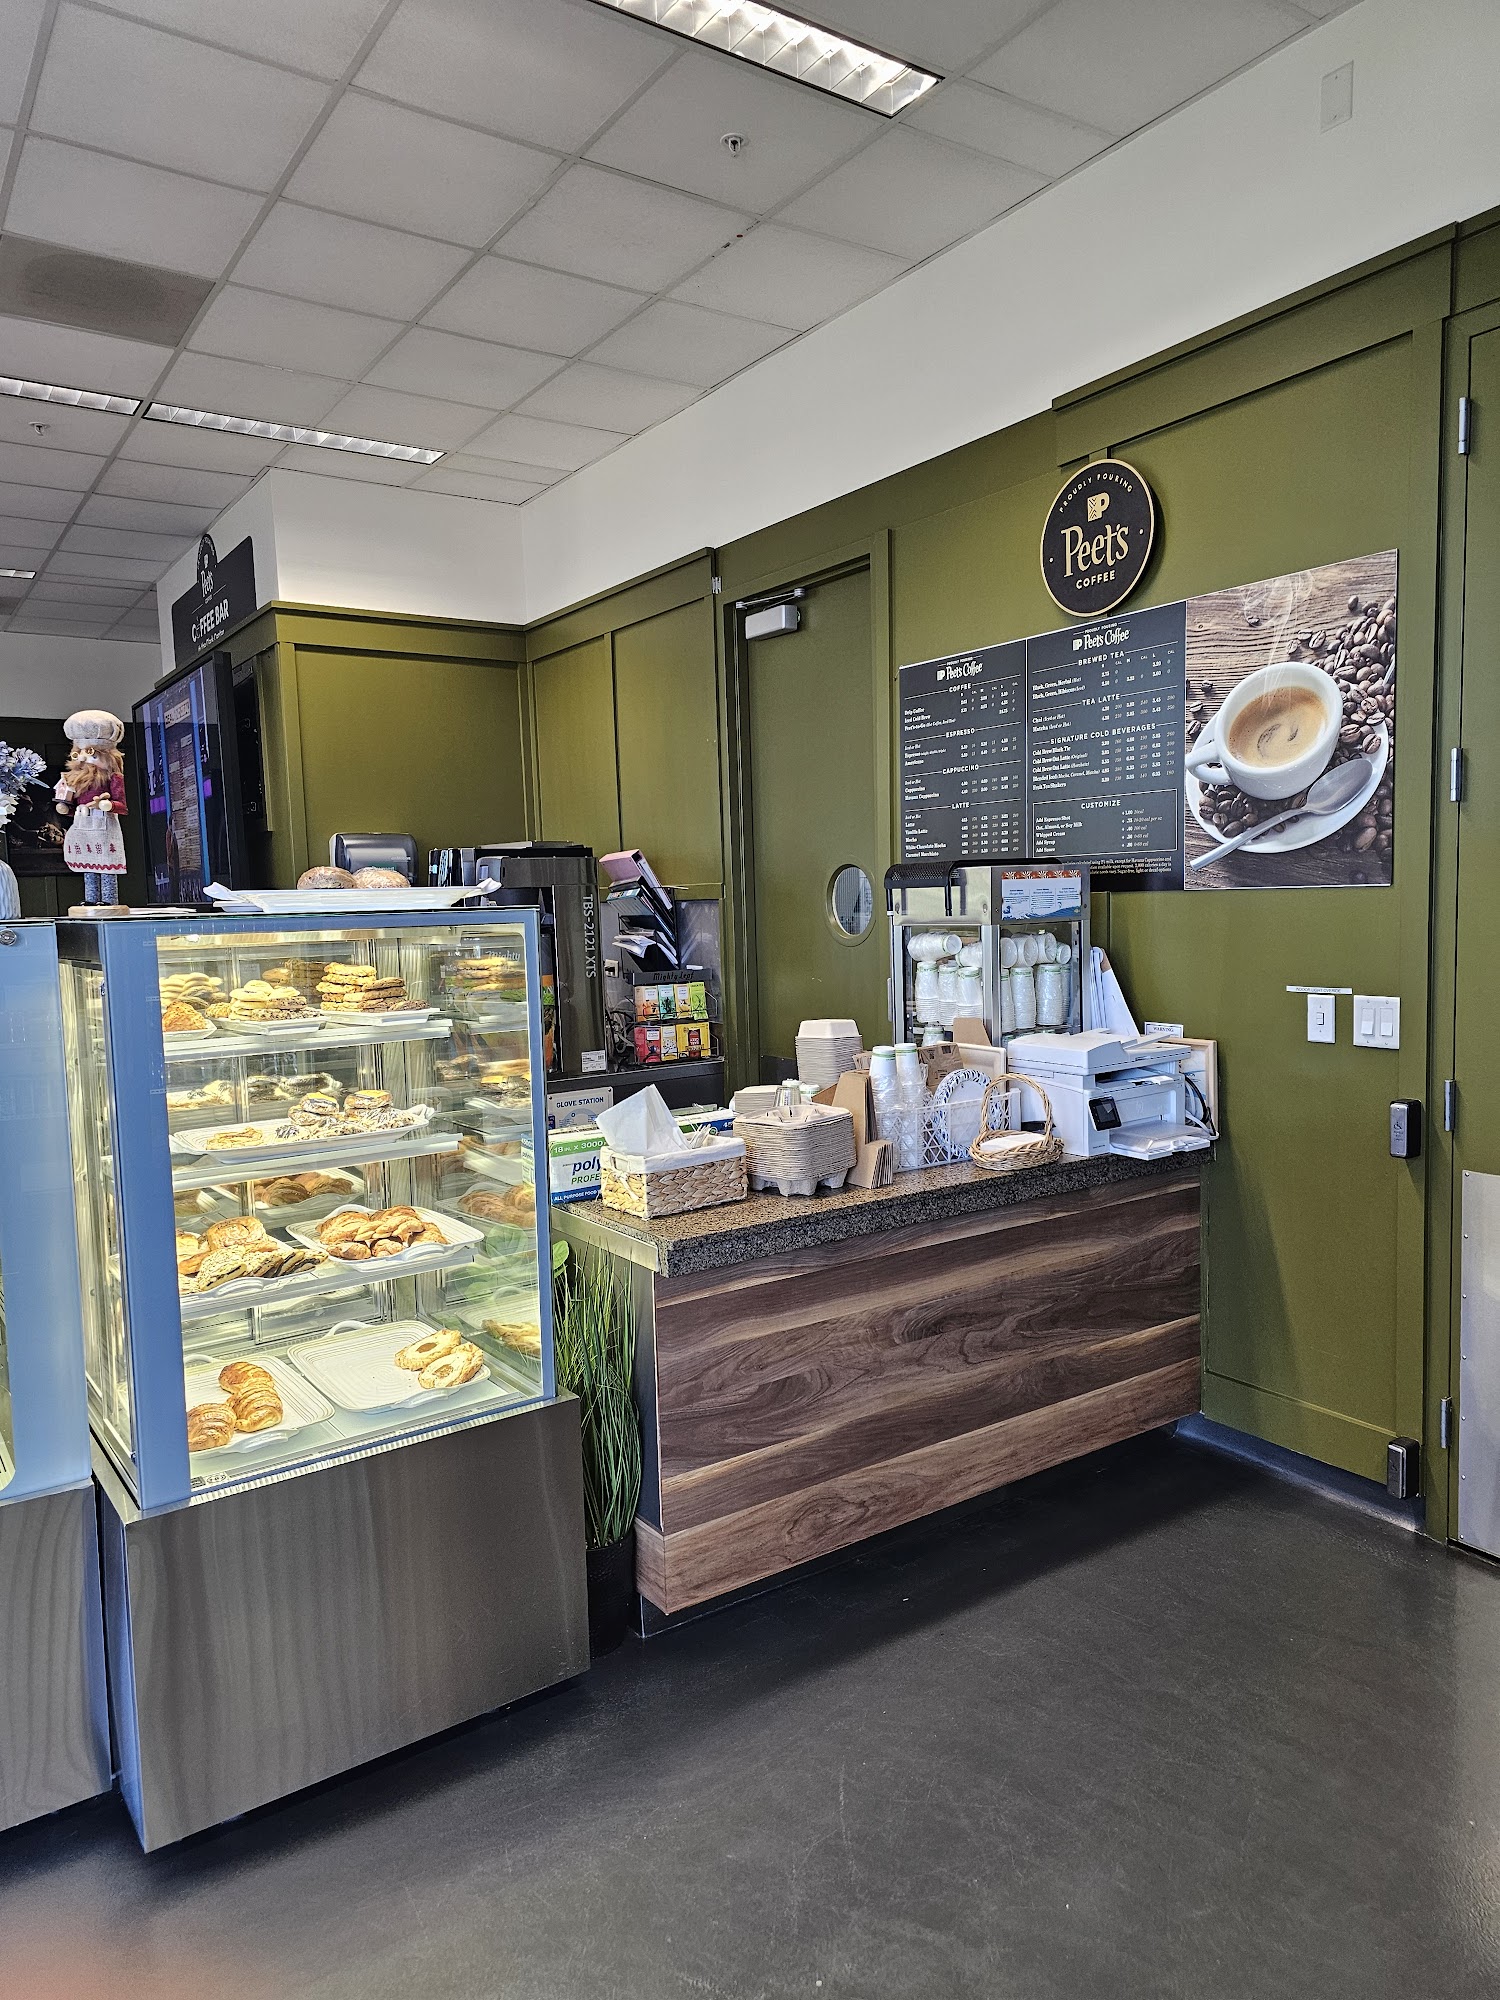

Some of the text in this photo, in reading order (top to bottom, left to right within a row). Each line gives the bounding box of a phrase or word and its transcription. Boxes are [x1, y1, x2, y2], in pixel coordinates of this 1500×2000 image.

[1059, 473, 1134, 513] PROUDLY POURING
[1061, 523, 1129, 577] Peet's
[1075, 569, 1116, 590] COFFEE
[214, 598, 229, 626] BAR
[1083, 627, 1130, 651] Peet's Coffee
[1078, 650, 1125, 666] BREWED TEA
[945, 660, 983, 681] Peet's Coffee
[949, 682, 972, 693] COFFEE
[1082, 693, 1121, 706] TEA LATTE
[945, 728, 975, 739] ESPRESSO
[1050, 722, 1157, 746] SIGNATURE COLD BEVERAGES
[942, 764, 980, 775] CAPPUCCINO
[951, 801, 970, 810] LATTE
[1080, 799, 1121, 810] CUSTOMIZE
[582, 893, 597, 979] TBS-2121 XTS
[653, 971, 679, 981] Mighty
[556, 1096, 604, 1108] GLOVE STATION
[554, 1146, 564, 1154] 18
[581, 1140, 604, 1149] 3000
[564, 1191, 584, 1200] PURPOSE
